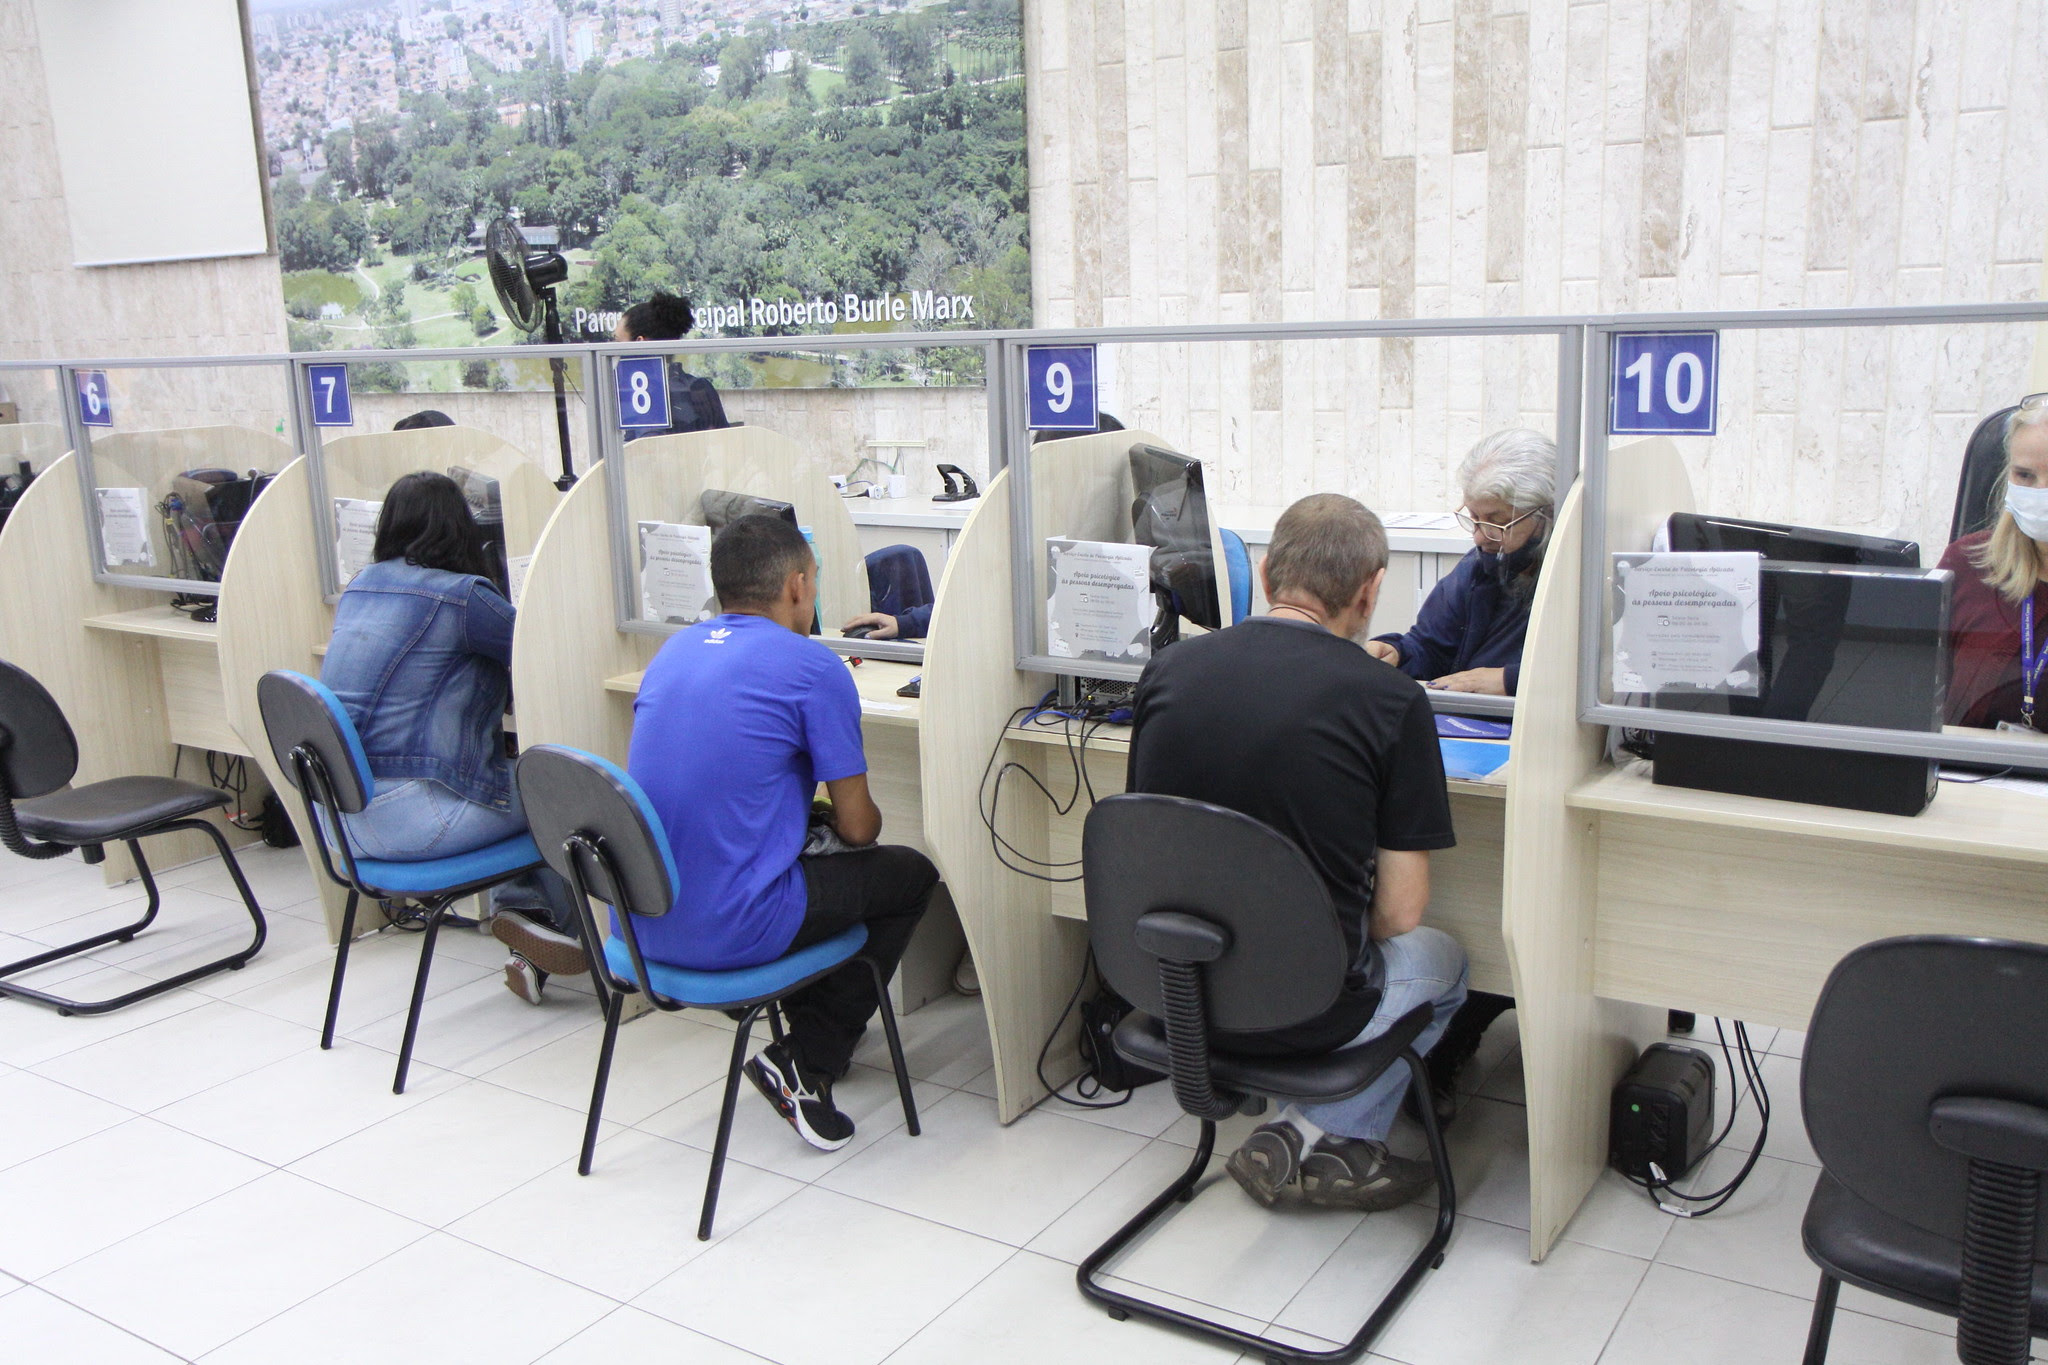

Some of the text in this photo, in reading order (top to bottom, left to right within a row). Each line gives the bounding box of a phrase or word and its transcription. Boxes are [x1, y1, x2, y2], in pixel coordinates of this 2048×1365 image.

[751, 297, 838, 327] Roberto
[844, 292, 906, 323] Burle
[911, 290, 975, 320] Marx
[86, 382, 101, 415] 6
[320, 377, 336, 414] 7
[630, 371, 651, 414] 8
[1045, 362, 1073, 413] 9
[1625, 352, 1703, 414] 10
[1642, 599, 1672, 608] pessoas
[1674, 599, 1737, 608] desempregadas
[1649, 588, 1717, 599] Apoio psicológico
